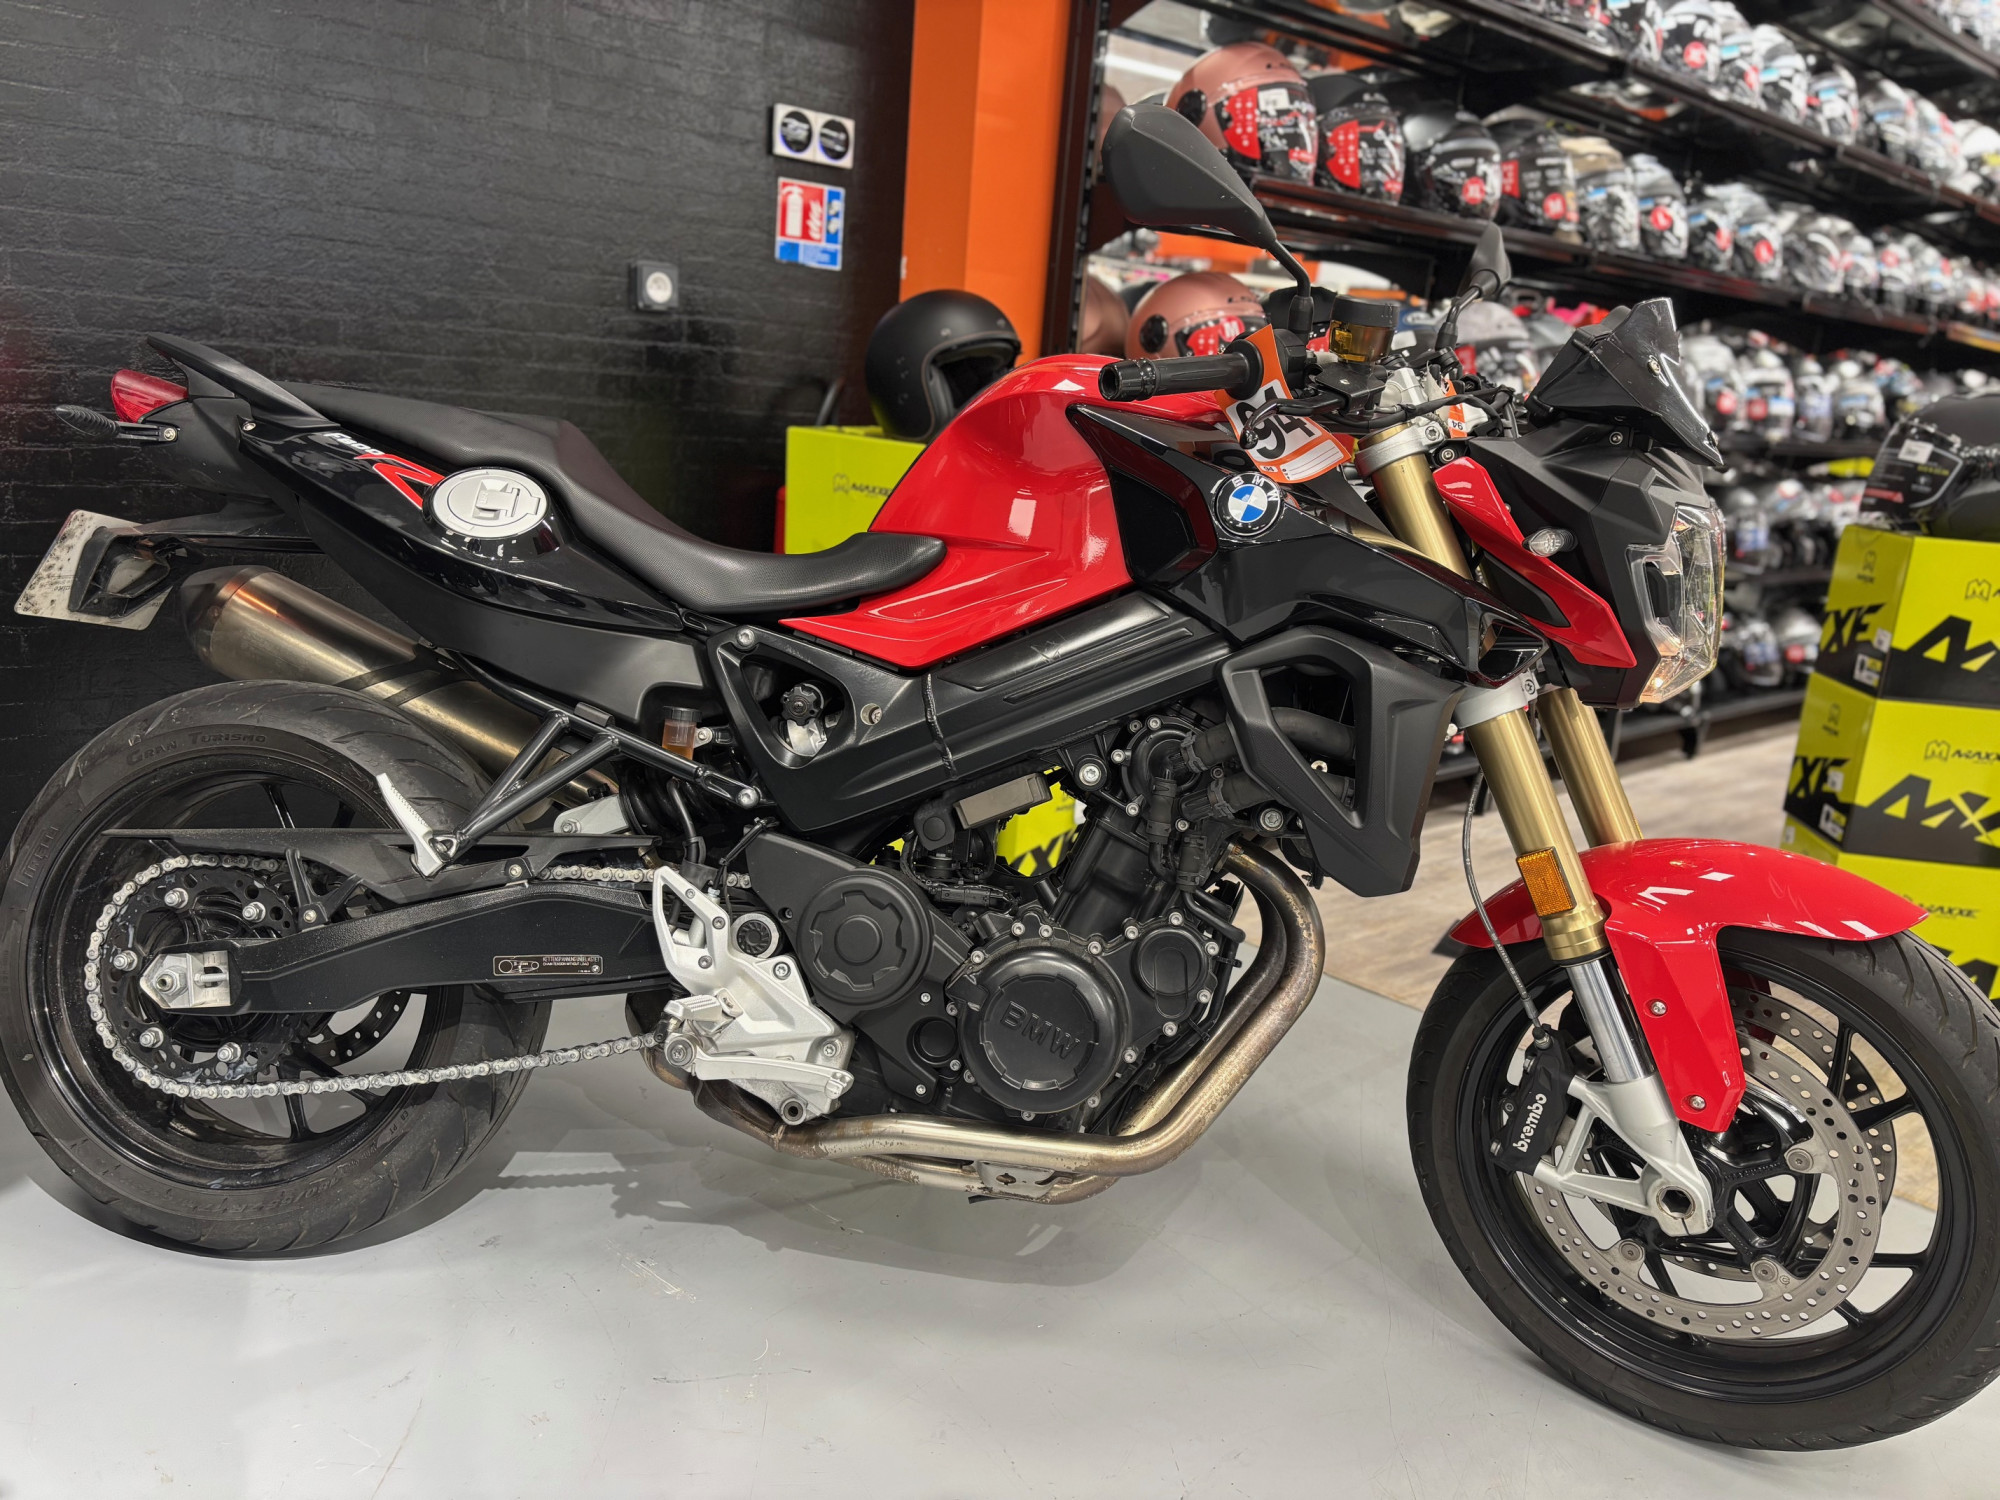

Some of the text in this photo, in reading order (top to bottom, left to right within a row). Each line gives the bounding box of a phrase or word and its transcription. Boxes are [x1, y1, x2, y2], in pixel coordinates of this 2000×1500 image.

[1223, 320, 1241, 339] M
[1235, 385, 1316, 460] 94
[1231, 473, 1280, 502] BMW
[126, 731, 267, 766] GRAN TURISMO
[13, 825, 60, 887] PIRELLI
[1000, 1000, 1081, 1060] BMW
[1512, 1093, 1548, 1153] brembo
